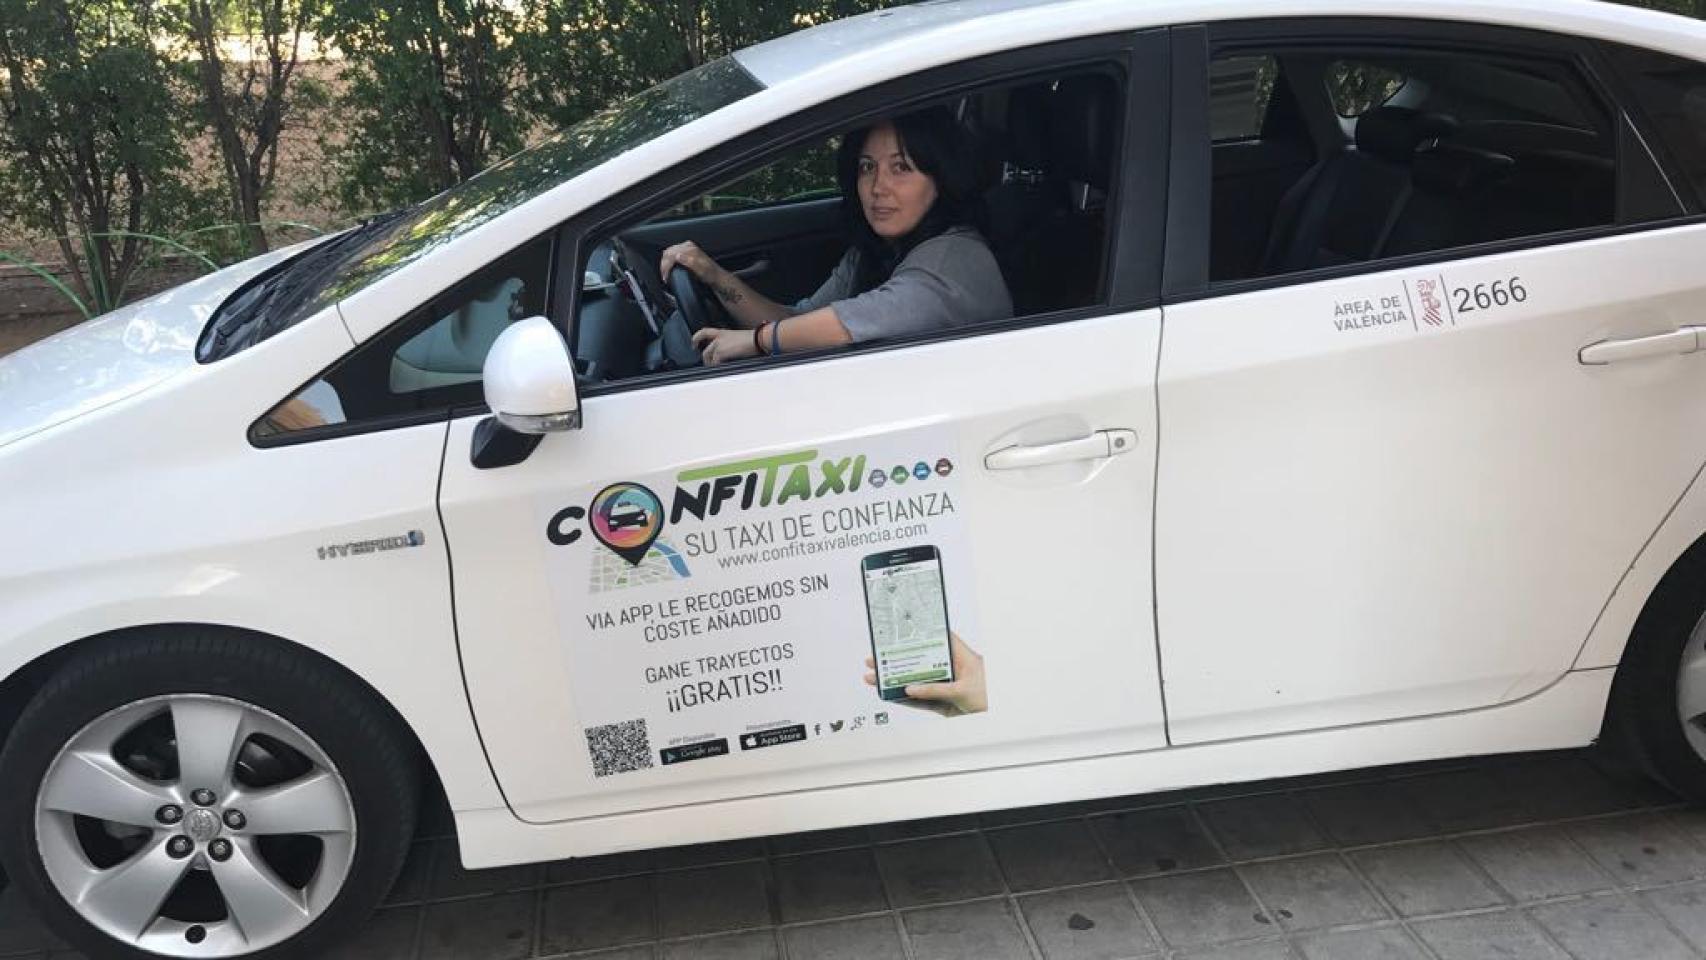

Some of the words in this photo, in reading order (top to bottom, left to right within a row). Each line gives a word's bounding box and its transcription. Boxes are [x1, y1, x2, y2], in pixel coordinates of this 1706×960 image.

[1381, 296, 1401, 309] DE
[1453, 276, 1527, 312] 2666
[685, 530, 717, 556] SU
[725, 521, 774, 550] TAXI
[782, 514, 815, 541] DE
[822, 491, 955, 533] CONFIANZA
[718, 523, 928, 568] www.confitaxivalencia.com
[586, 612, 615, 631] VIA
[658, 600, 681, 618] LE
[686, 579, 795, 614] RECOGEMOS
[799, 574, 829, 591] SIN
[644, 617, 701, 643] COSTE
[708, 604, 782, 632] AÑADIDO
[645, 661, 692, 684] GANE
[697, 643, 794, 674] TRAYECTOS
